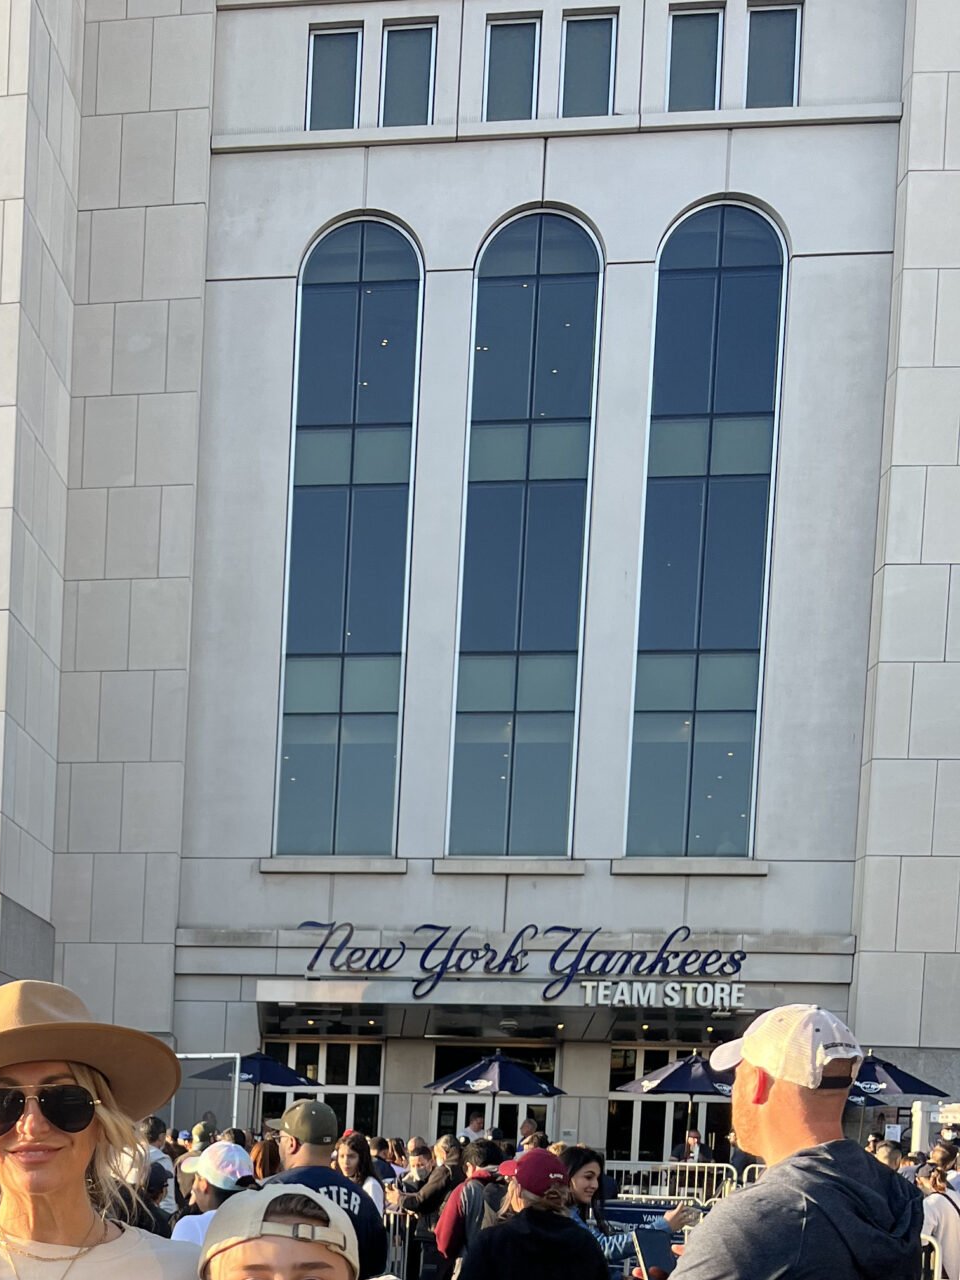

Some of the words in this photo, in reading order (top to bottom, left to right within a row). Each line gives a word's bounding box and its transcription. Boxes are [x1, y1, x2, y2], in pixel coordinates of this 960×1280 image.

[297, 920, 406, 974] New
[412, 923, 539, 1000] York
[542, 924, 747, 1000] Yankees
[581, 981, 656, 1007] TEAM
[663, 982, 746, 1008] STORE
